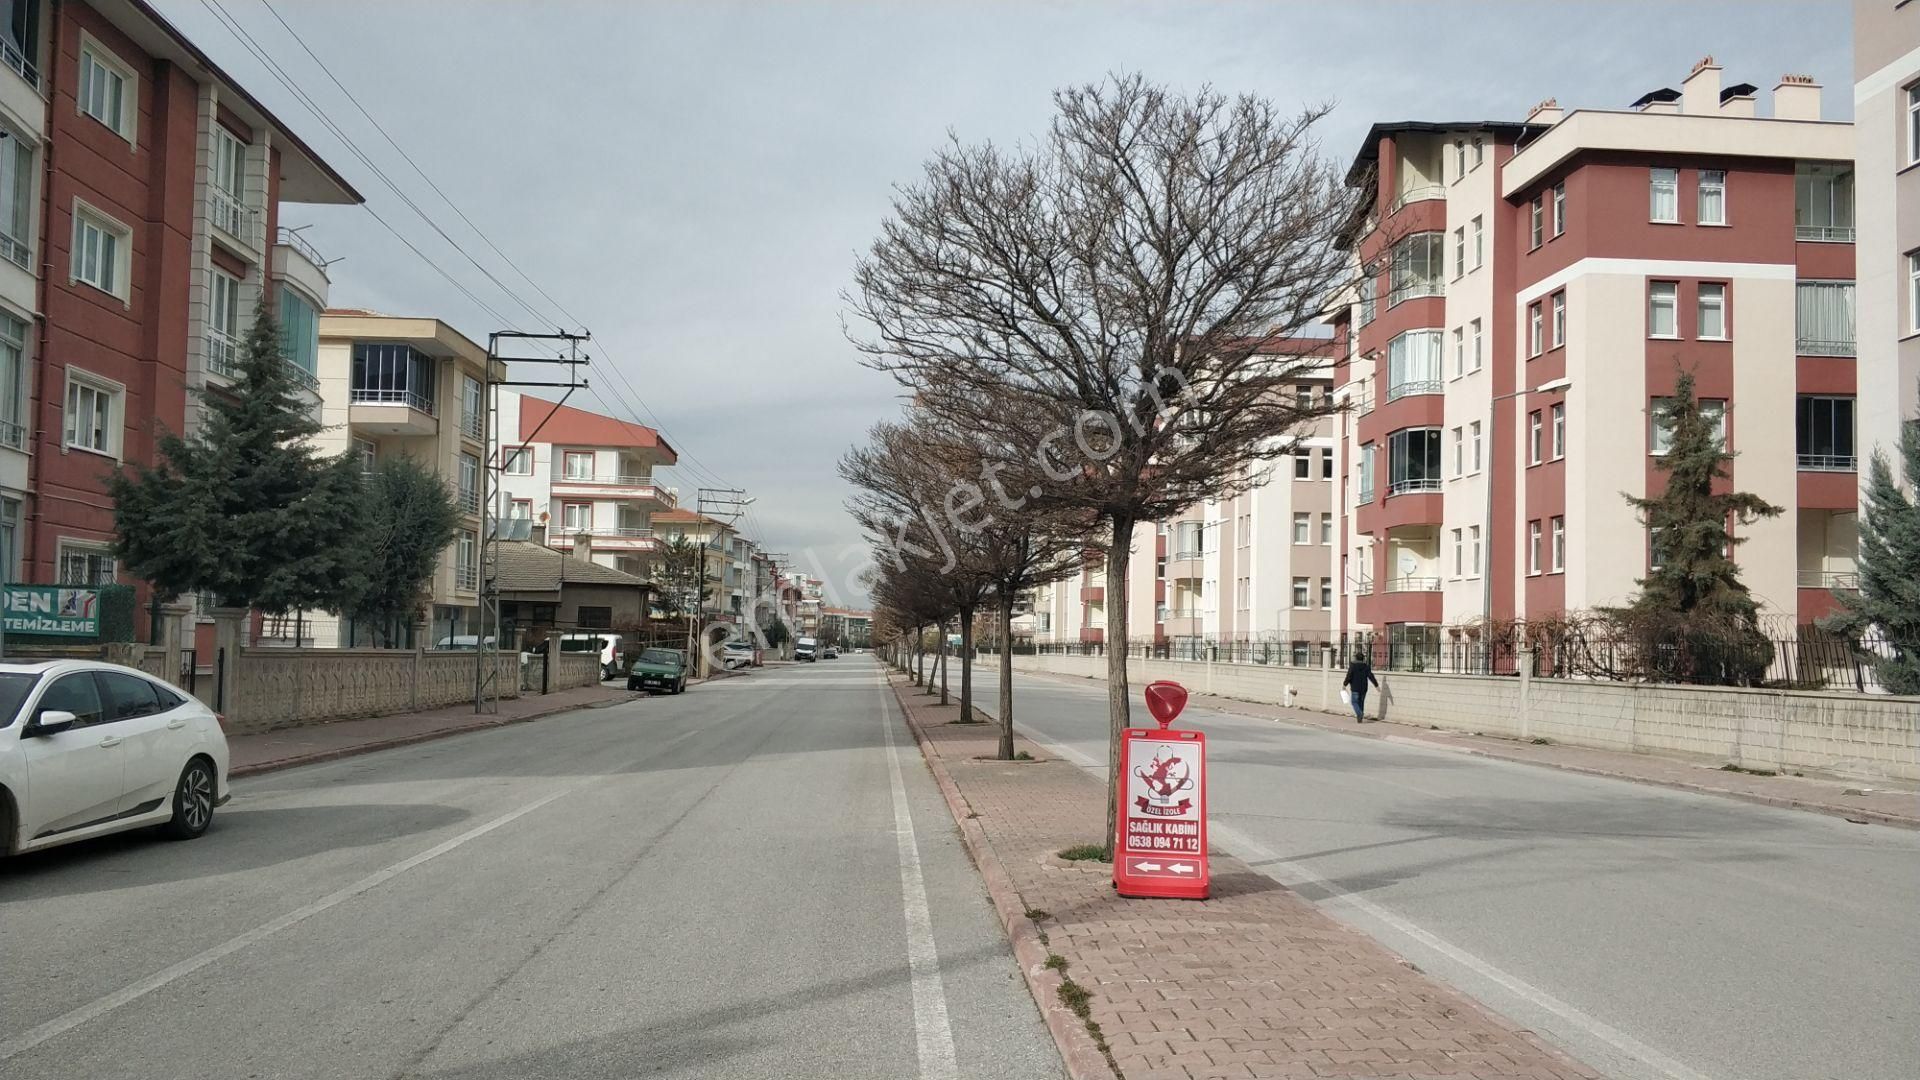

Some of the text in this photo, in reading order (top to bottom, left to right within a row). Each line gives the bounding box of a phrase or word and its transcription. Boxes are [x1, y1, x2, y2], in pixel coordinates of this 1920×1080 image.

[4, 616, 95, 633] TEMİZLEME
[1146, 805, 1162, 815] ÖZEL
[1129, 820, 1197, 836] SAĞLIK KABİNİ
[1129, 835, 1198, 850] 0538 094 71 12
